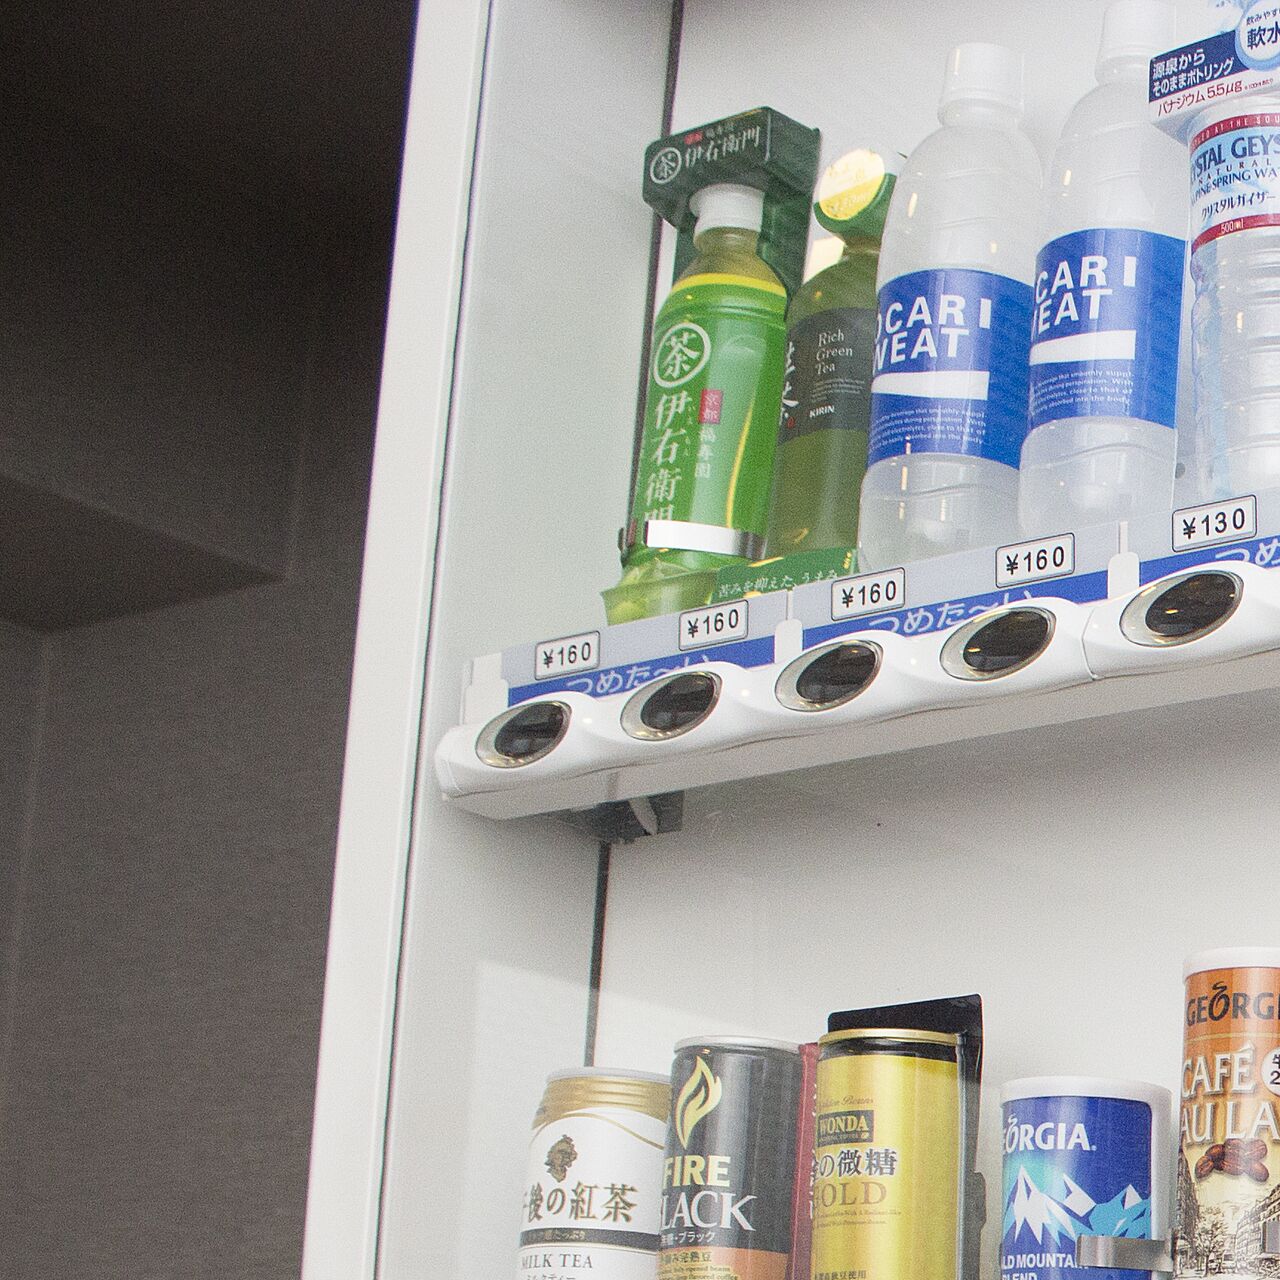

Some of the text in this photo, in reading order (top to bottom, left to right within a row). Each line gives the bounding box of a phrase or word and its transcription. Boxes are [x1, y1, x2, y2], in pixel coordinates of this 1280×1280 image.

[1153, 49, 1206, 80] 源泉から
[1158, 91, 1206, 116] バナジウム
[1199, 158, 1272, 185] NATURAL
[1212, 169, 1251, 188] SPRING
[1202, 191, 1276, 221] クリスタルガイザー
[818, 328, 845, 347] Rich
[664, 331, 700, 379] 茶
[815, 362, 836, 375] Tea
[816, 347, 853, 362] Green
[809, 404, 835, 419] KIRIN
[1182, 507, 1245, 540] ¥130
[1006, 546, 1065, 575] ¥160
[842, 580, 896, 608] ¥160
[688, 609, 739, 638] ¥160
[542, 641, 591, 668] ¥160
[1182, 1041, 1257, 1099] CAFÉ
[1180, 1104, 1213, 1147] AU
[663, 1154, 731, 1188] FIRE
[524, 1181, 638, 1224] 後の紅茶
[560, 1253, 593, 1269] TEA
